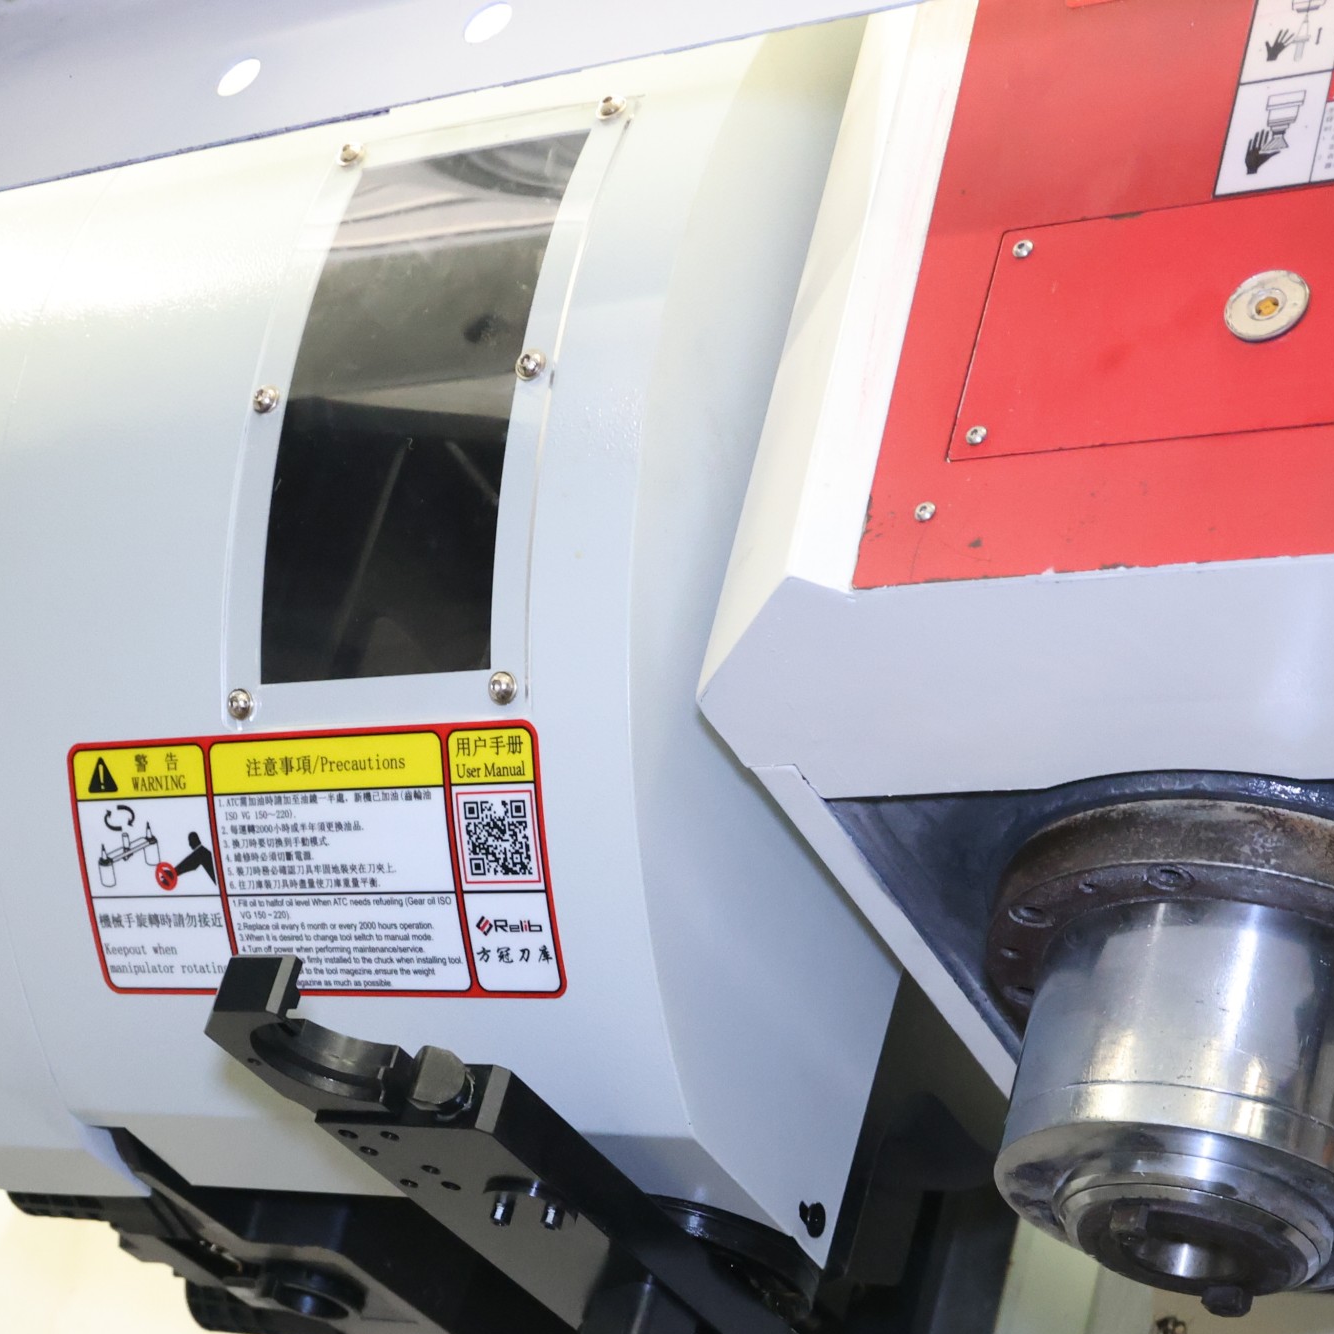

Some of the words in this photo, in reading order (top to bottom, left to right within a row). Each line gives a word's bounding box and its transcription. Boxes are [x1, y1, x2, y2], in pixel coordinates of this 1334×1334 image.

[456, 735, 523, 757] 用户手册
[134, 752, 178, 773] 警告
[456, 763, 481, 778] User
[484, 760, 526, 777] Manual
[131, 774, 186, 792] WARNING
[225, 811, 238, 820] ISO
[242, 811, 251, 820] VG
[259, 899, 264, 907] to
[312, 898, 333, 906] When
[350, 898, 371, 906] needs
[373, 897, 403, 907] refueling
[405, 897, 425, 907] (Gear
[427, 897, 435, 905] oil
[438, 896, 451, 905] ISO
[240, 911, 252, 919] VG
[254, 911, 266, 919] 150
[301, 922, 305, 930] 6
[307, 922, 328, 930] month
[339, 923, 357, 931] every
[359, 922, 376, 930] 2000
[378, 921, 397, 929] hours
[400, 922, 434, 930] operation.
[493, 919, 543, 932] Relib
[313, 934, 338, 942] change
[340, 933, 352, 941] tool
[384, 933, 409, 941] manual
[412, 933, 434, 941] mode.
[104, 943, 147, 957] Keepout
[152, 943, 178, 955] when
[274, 946, 293, 954] power
[315, 946, 351, 954] performing
[307, 956, 322, 964] firmly
[325, 956, 352, 964] installed
[353, 956, 360, 964] to
[361, 956, 372, 964] the
[374, 956, 394, 964] chuck
[396, 956, 415, 964] when
[416, 956, 447, 966] installing
[109, 961, 175, 975] manipulator
[307, 967, 312, 975] to
[314, 967, 324, 975] the
[326, 967, 338, 975] tool
[400, 967, 410, 975] the
[412, 968, 435, 977] weight
[297, 980, 322, 988] agazine
